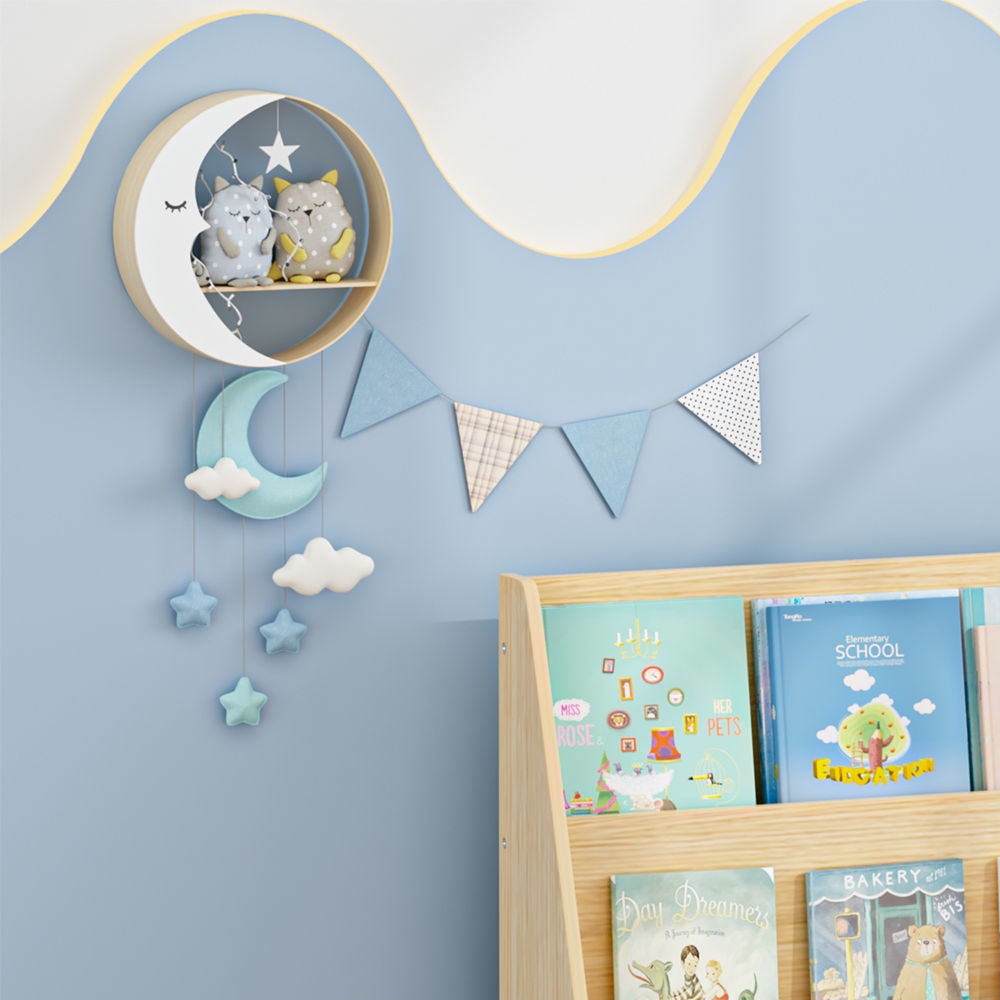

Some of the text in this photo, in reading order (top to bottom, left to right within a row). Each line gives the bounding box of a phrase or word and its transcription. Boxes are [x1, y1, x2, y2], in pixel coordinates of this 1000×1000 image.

[845, 634, 890, 645] Elementary
[835, 643, 905, 660] SCHOOL
[561, 703, 581, 716] MISS
[713, 698, 733, 714] HER
[557, 723, 596, 748] ROSE
[707, 716, 742, 737] PETS
[843, 869, 922, 890] BAKERY
[615, 879, 769, 933] Day Dreamers
